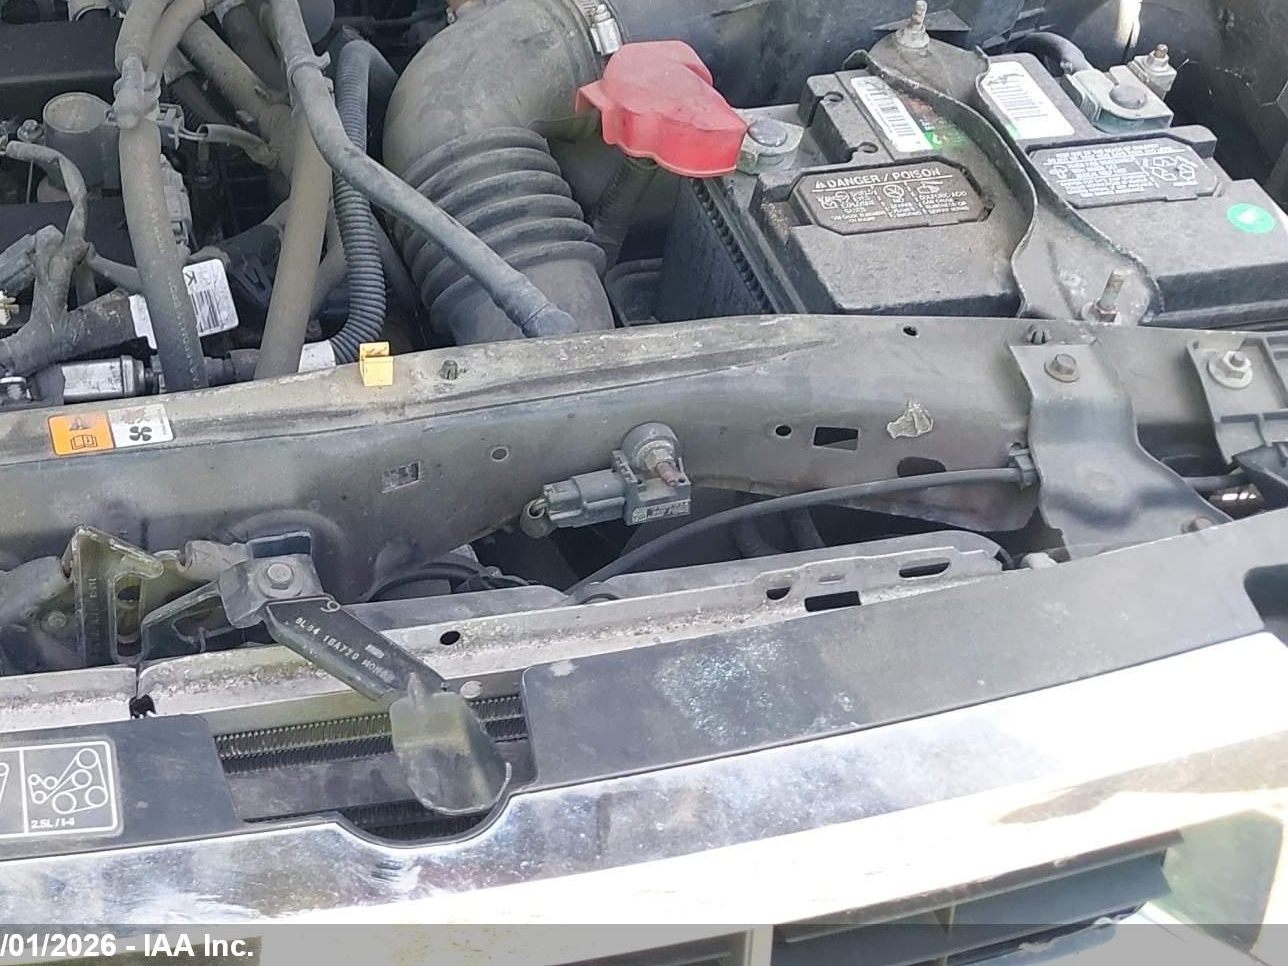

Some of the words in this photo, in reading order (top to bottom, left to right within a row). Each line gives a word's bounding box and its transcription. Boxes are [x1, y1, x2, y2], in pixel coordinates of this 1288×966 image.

[825, 174, 880, 189] DANGER
[891, 167, 941, 181] POISON
[31, 819, 54, 829] 2.5L
[61, 817, 75, 827] I-4
